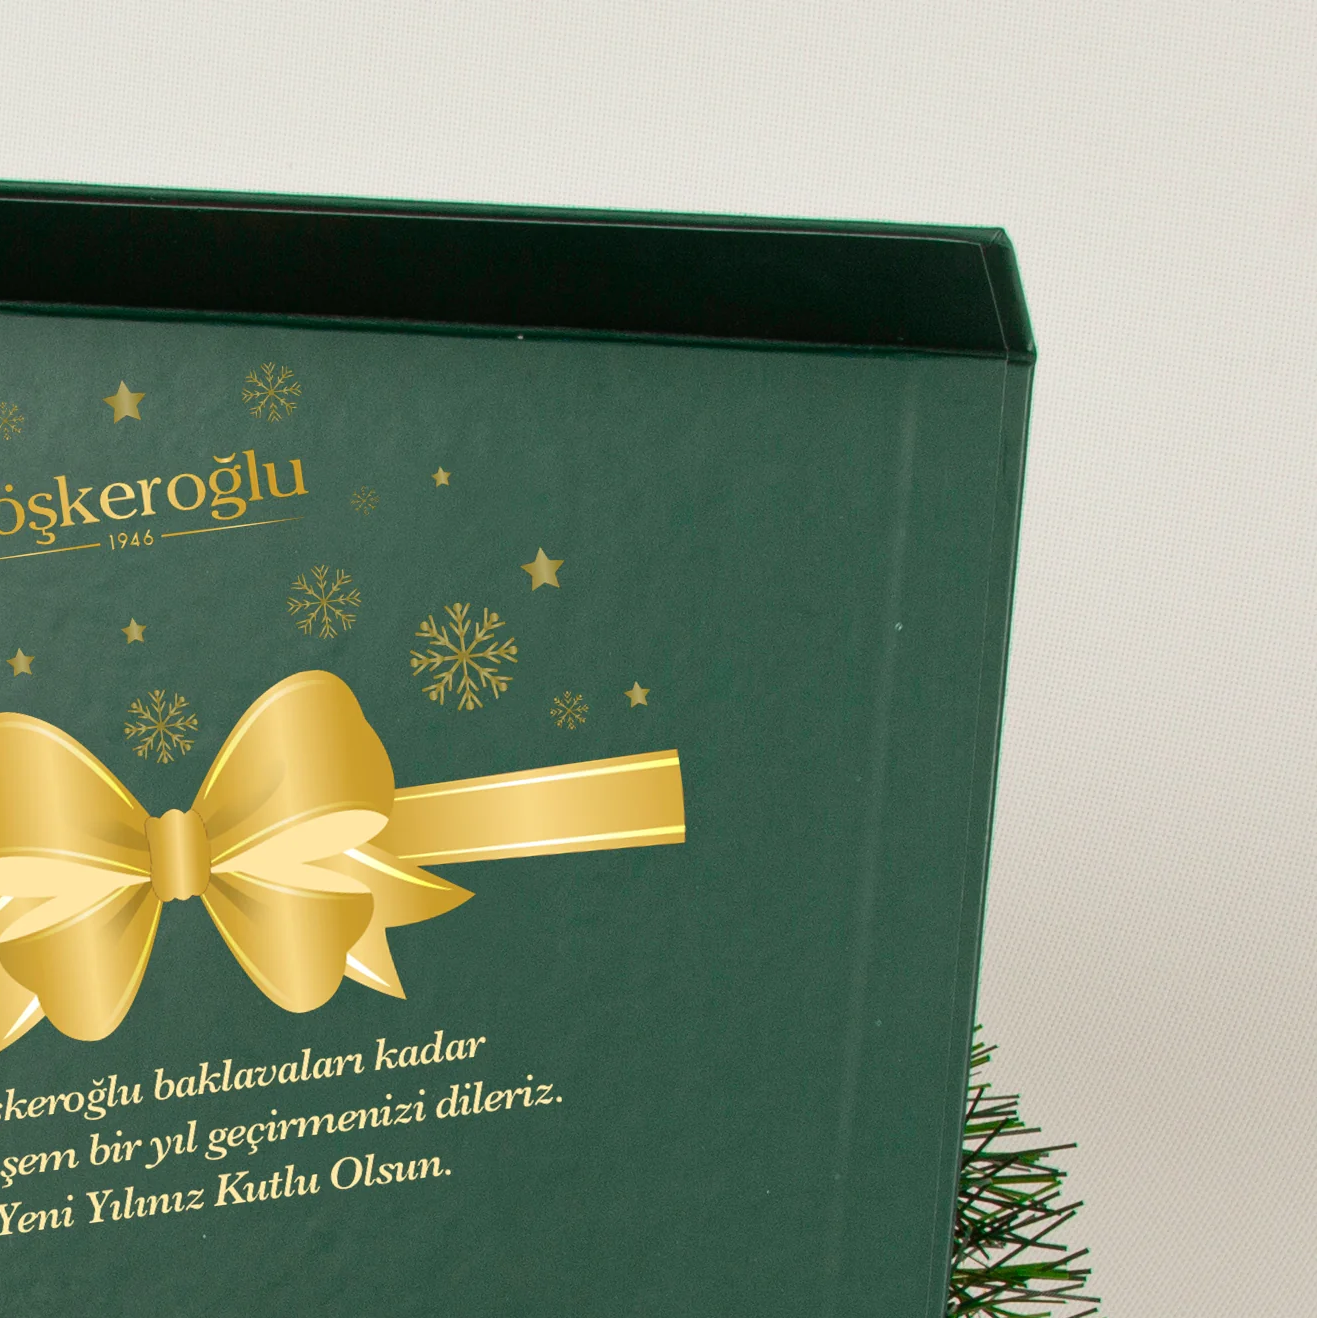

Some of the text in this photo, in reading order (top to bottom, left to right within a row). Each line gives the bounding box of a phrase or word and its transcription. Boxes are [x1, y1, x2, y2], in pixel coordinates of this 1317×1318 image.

[108, 529, 155, 551] 1946
[154, 1047, 365, 1101] baklavaları
[374, 1030, 487, 1071] kadar
[89, 1129, 142, 1166] bir
[145, 1119, 198, 1169] yıl
[204, 1088, 427, 1161] geçirmenizi
[435, 1073, 563, 1119] dileriz.
[86, 1185, 205, 1224] Yılınız
[213, 1164, 322, 1207] Kutlu
[330, 1153, 452, 1190] Olsun.
